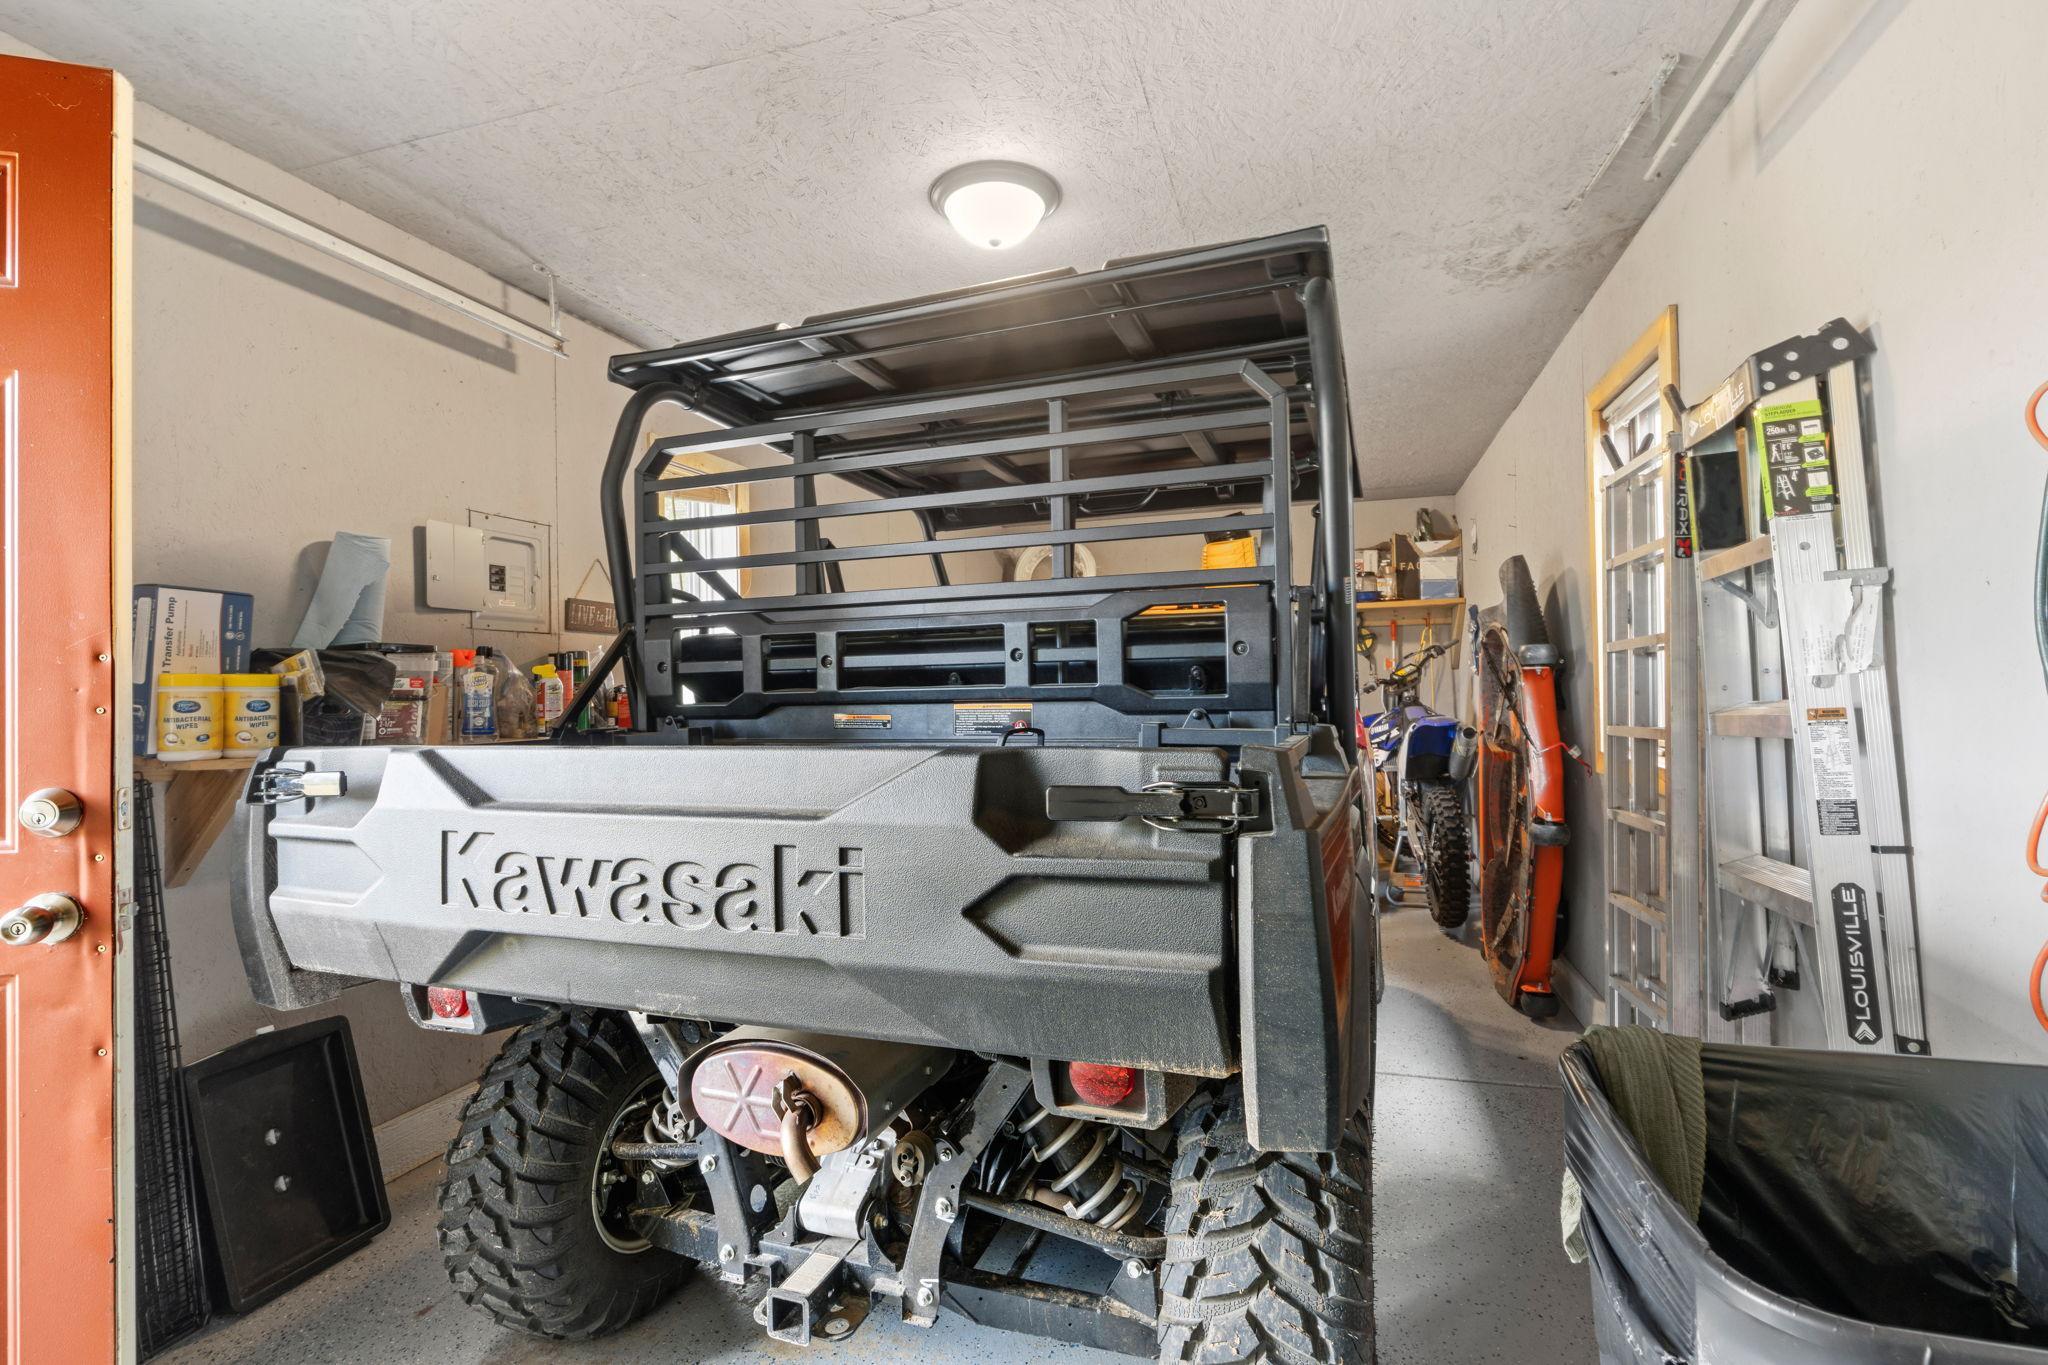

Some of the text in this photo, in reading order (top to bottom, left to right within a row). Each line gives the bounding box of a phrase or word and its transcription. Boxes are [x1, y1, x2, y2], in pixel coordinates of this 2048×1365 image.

[162, 597, 178, 668] Transfer Pump
[163, 715, 212, 723] ANTIBACTERIAL
[175, 722, 199, 730] WIPES
[249, 721, 269, 729] WIPES
[441, 829, 866, 939] Kawasaki
[1841, 887, 1871, 1020] LOUISVILLE
